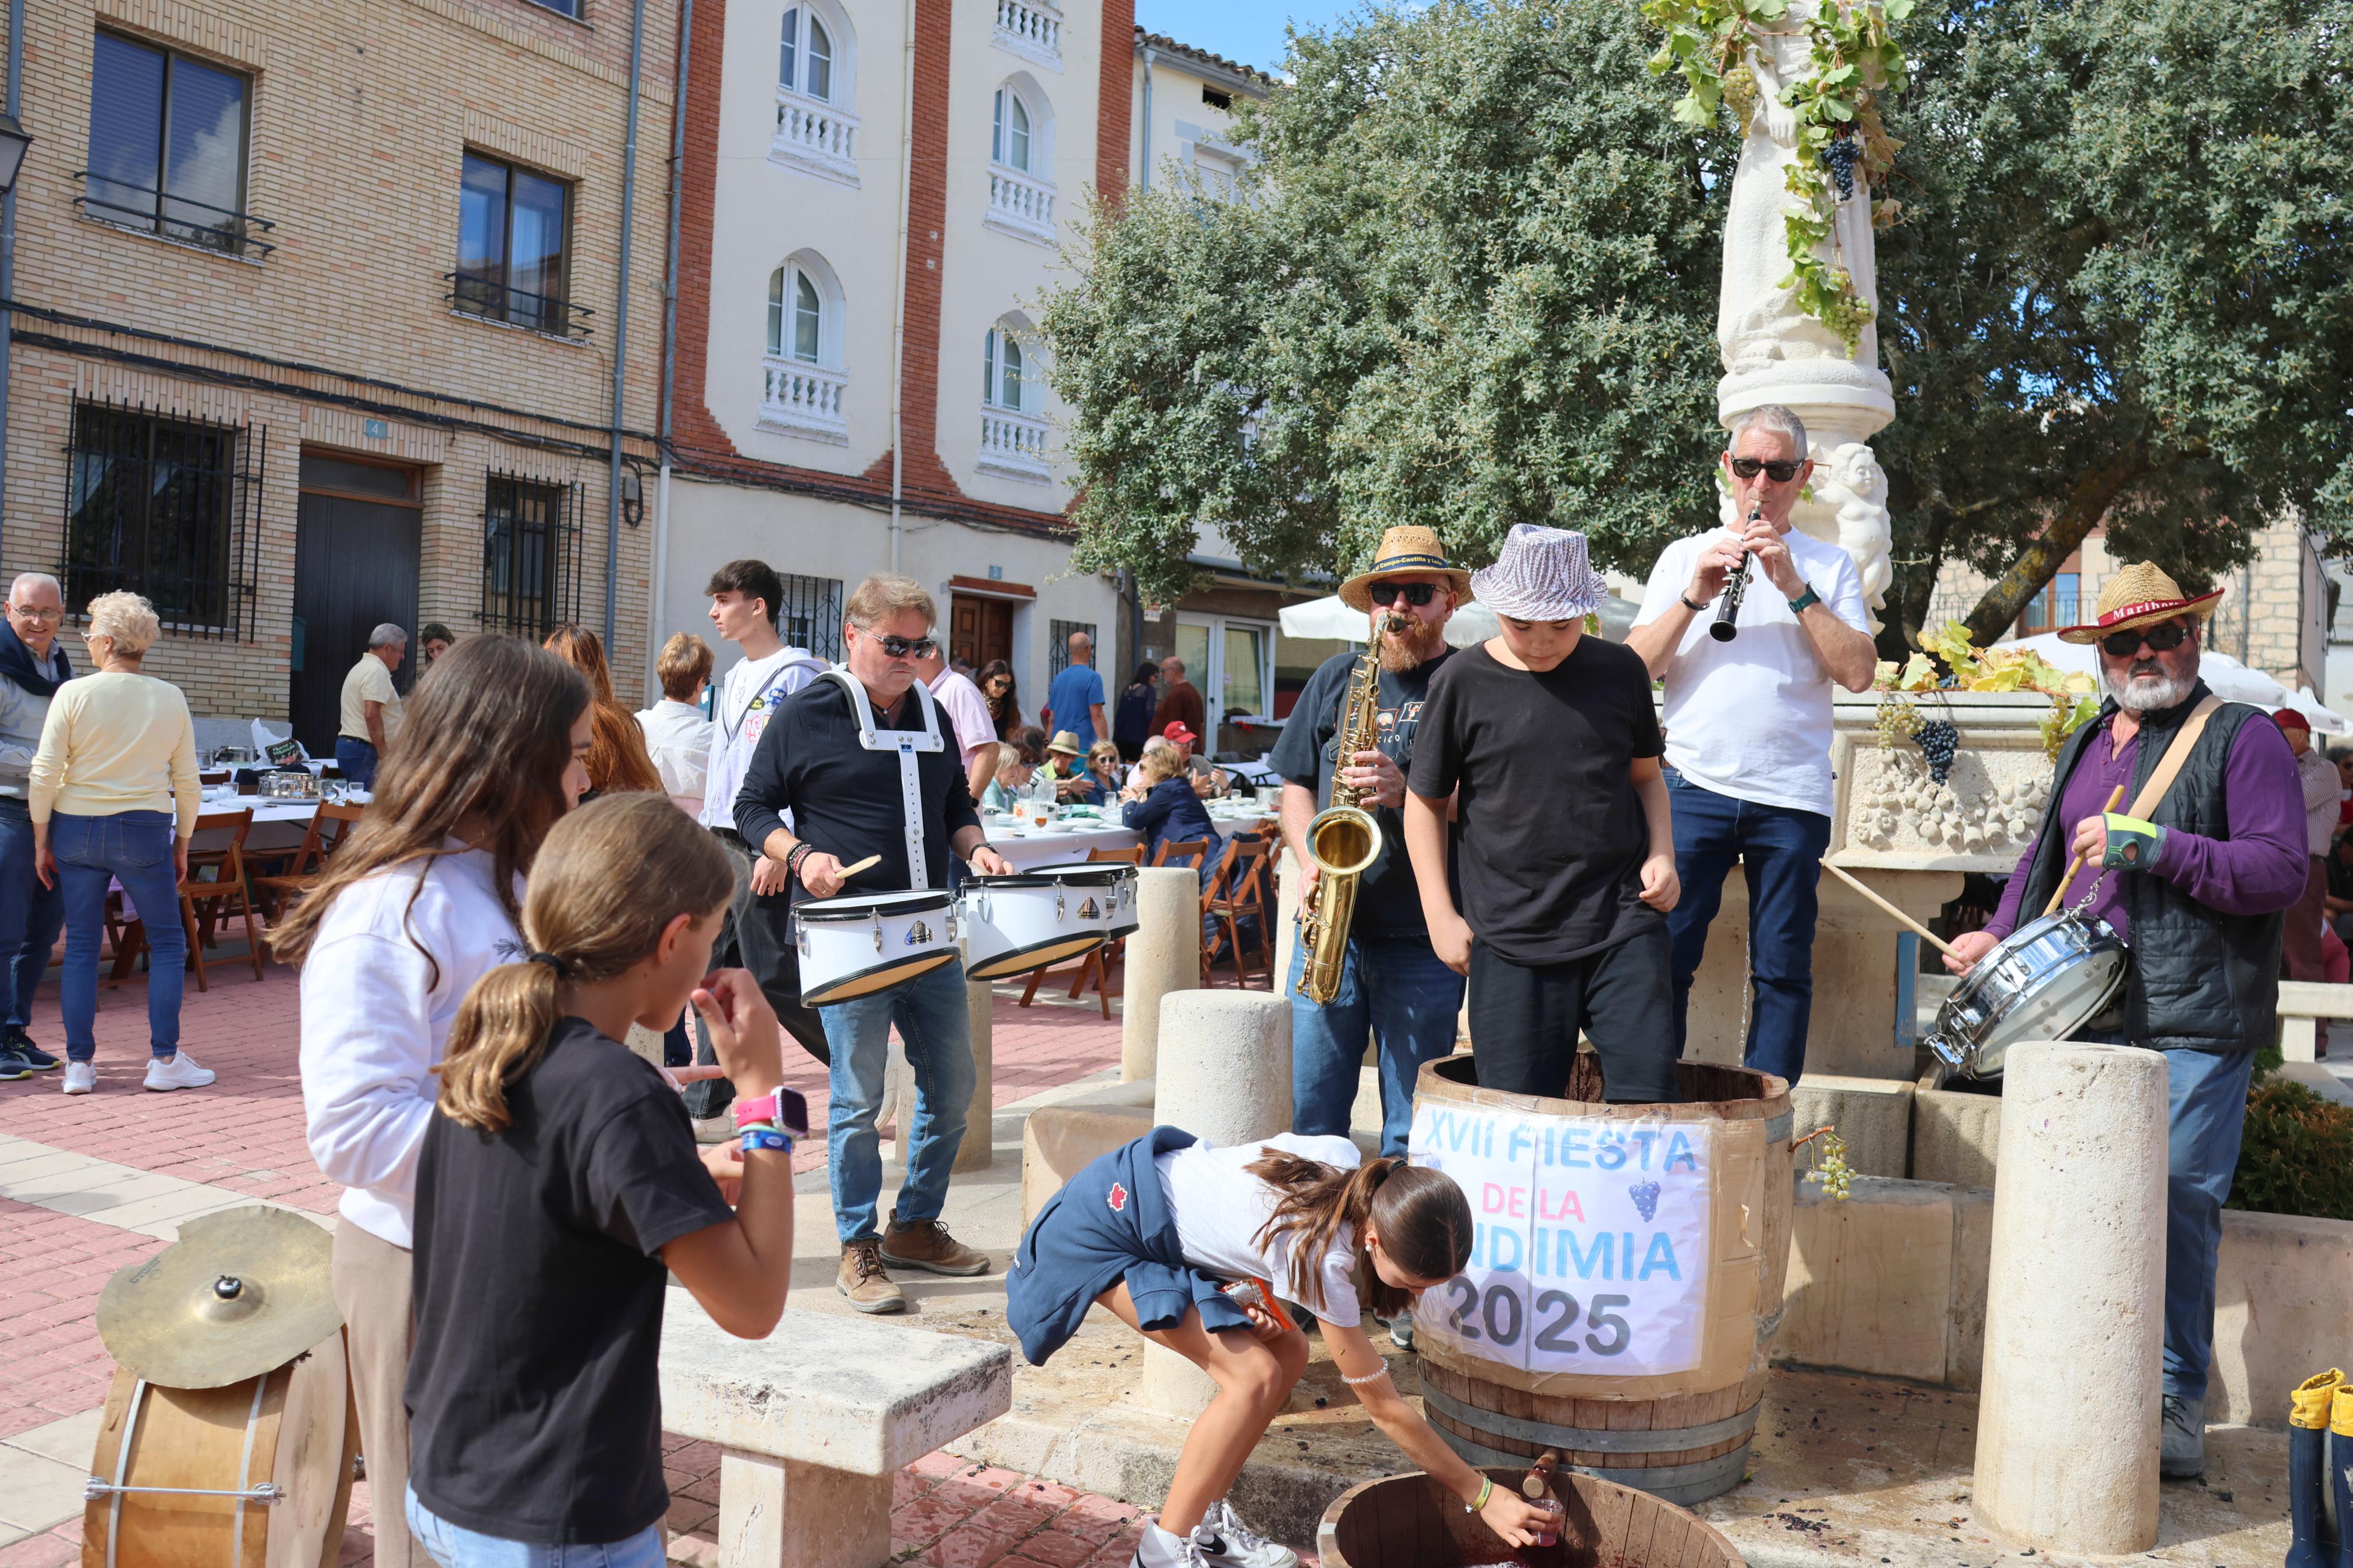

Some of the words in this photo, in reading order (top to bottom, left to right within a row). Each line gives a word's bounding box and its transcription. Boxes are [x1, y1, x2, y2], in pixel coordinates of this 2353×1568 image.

[372, 423, 378, 435] 4
[1380, 556, 1426, 568] Campo-Castilla
[1424, 1109, 1493, 1158] XVII
[1508, 1123, 1696, 1172] FIESTA
[1482, 1182, 1527, 1219] DE
[1539, 1188, 1586, 1224] LA
[1470, 1222, 1683, 1281] NDIMIA
[1447, 1274, 1631, 1356] 2025
